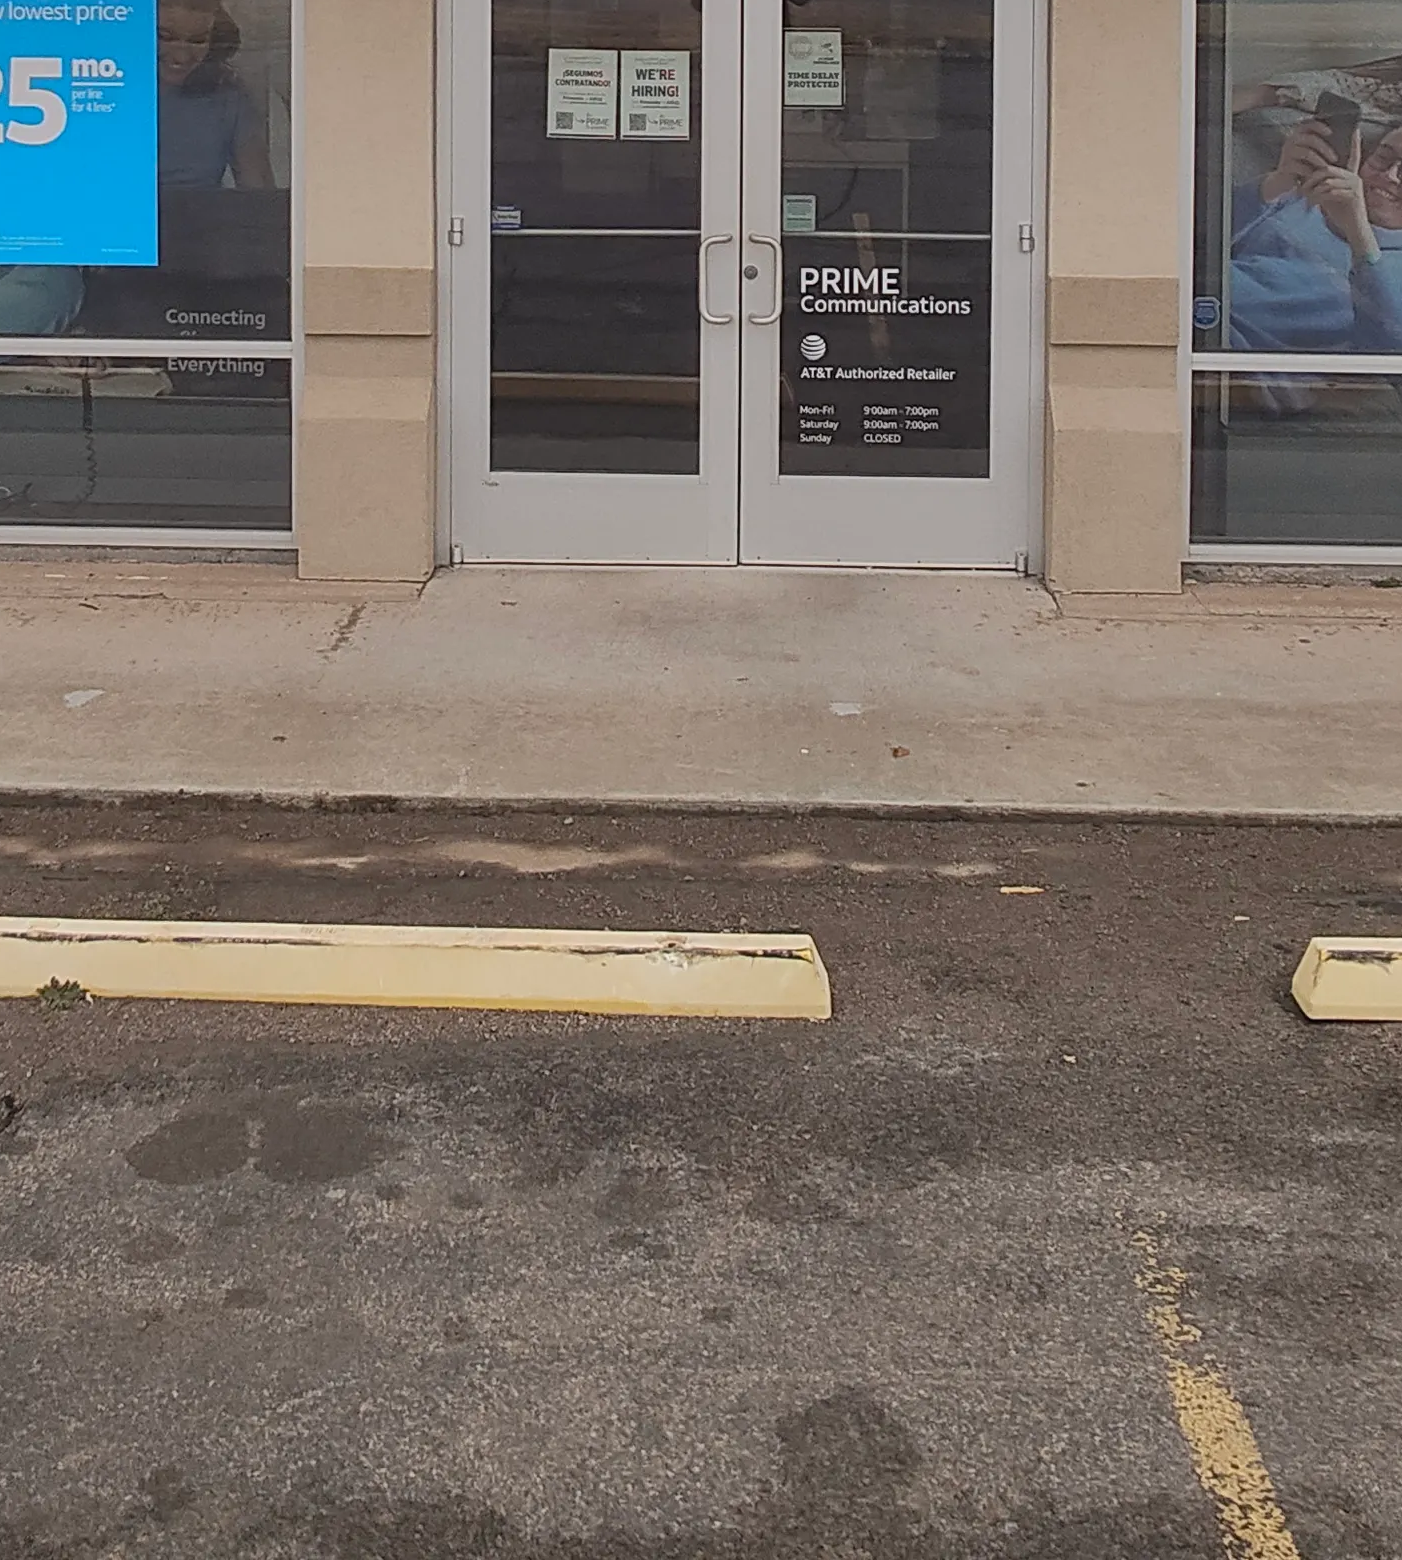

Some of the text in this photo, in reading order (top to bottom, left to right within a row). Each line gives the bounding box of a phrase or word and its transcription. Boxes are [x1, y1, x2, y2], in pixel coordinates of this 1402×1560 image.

[8, 1, 72, 21] lowest
[71, 57, 124, 78] mo.
[635, 68, 677, 81] WE'RE
[787, 72, 840, 80] TIME DELAY
[554, 79, 612, 88] CONTRATANDO!
[787, 81, 840, 89] PROTECTED
[631, 85, 680, 98] HIRING!
[71, 100, 85, 112] for
[799, 267, 900, 294] PRIME
[800, 294, 972, 316] Communications
[165, 308, 266, 330] Connecting
[167, 356, 265, 378] Everything
[800, 367, 957, 381] AT&T Authorized Retailer
[799, 405, 835, 415] Mon-Fri
[863, 406, 897, 416] 9:00am
[904, 406, 939, 417] 7:00pm
[799, 419, 839, 431] Saturday
[863, 420, 897, 429] 9:00am
[904, 420, 939, 431] 7:00pm
[799, 433, 902, 444] Sunday CLOSED
